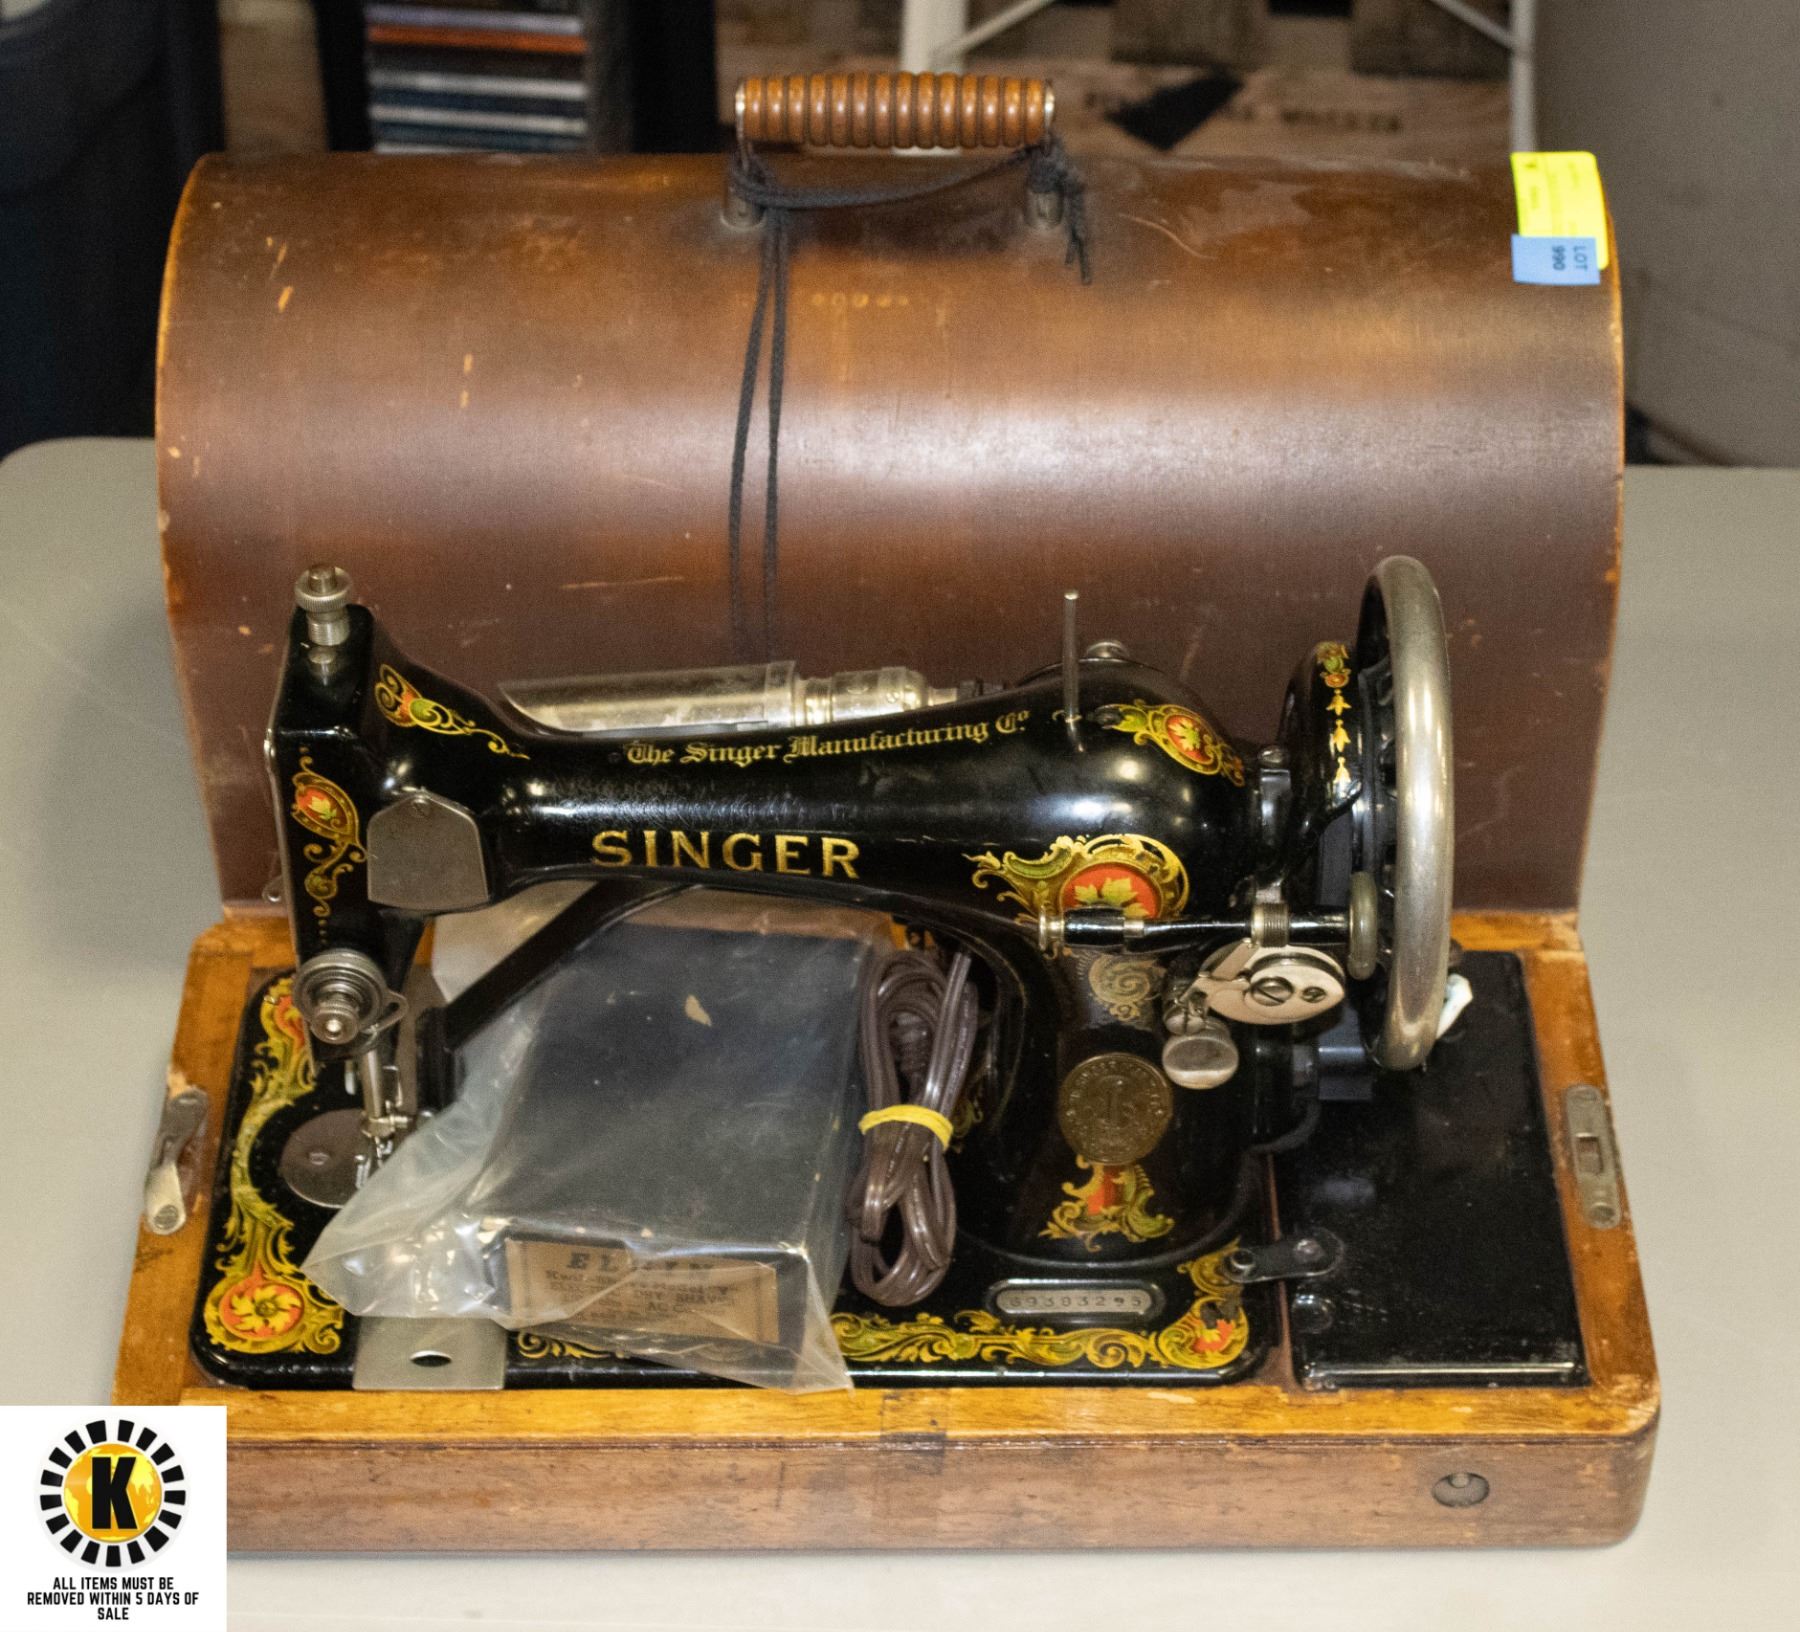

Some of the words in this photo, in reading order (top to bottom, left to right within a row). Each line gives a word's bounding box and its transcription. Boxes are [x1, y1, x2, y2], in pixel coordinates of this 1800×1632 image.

[1572, 245, 1588, 271] LOT
[626, 739, 675, 765] The
[679, 741, 781, 768] Singer
[783, 720, 989, 764] Manufacturing
[591, 829, 861, 880] SINGER
